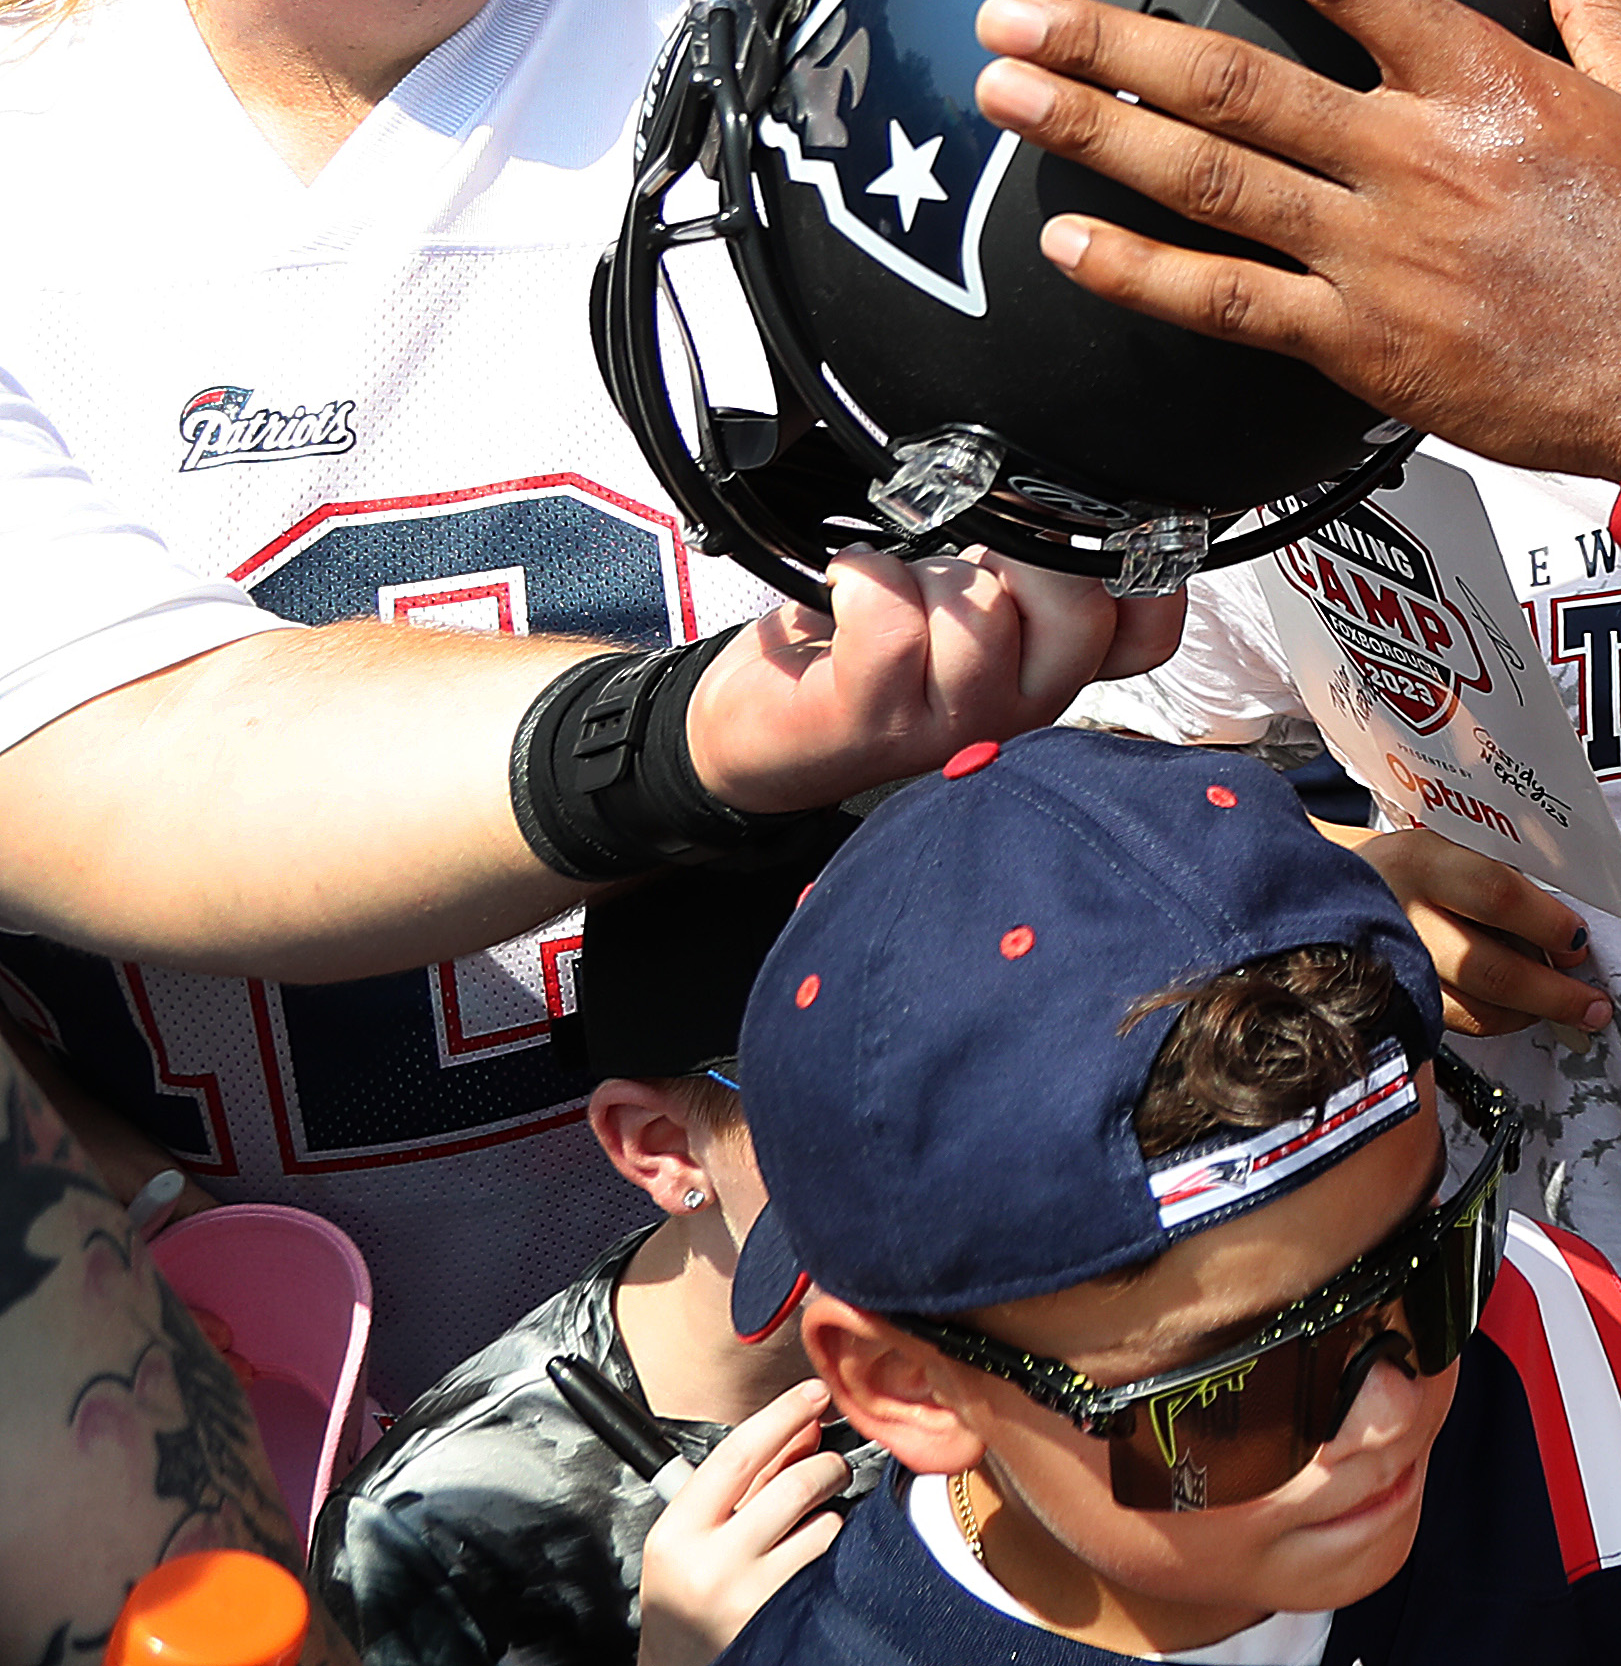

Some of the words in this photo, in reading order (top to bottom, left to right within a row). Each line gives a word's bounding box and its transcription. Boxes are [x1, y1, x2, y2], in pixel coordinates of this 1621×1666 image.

[179, 400, 356, 472] Patriots
[1285, 540, 1455, 659] CAMP
[1331, 612, 1440, 684] FOXBOROUGH
[1364, 664, 1436, 709] 2023
[1386, 752, 1522, 845] Optum
[1473, 726, 1573, 812] Cassidy
[1257, 1075, 1406, 1168] PATRIOTS
